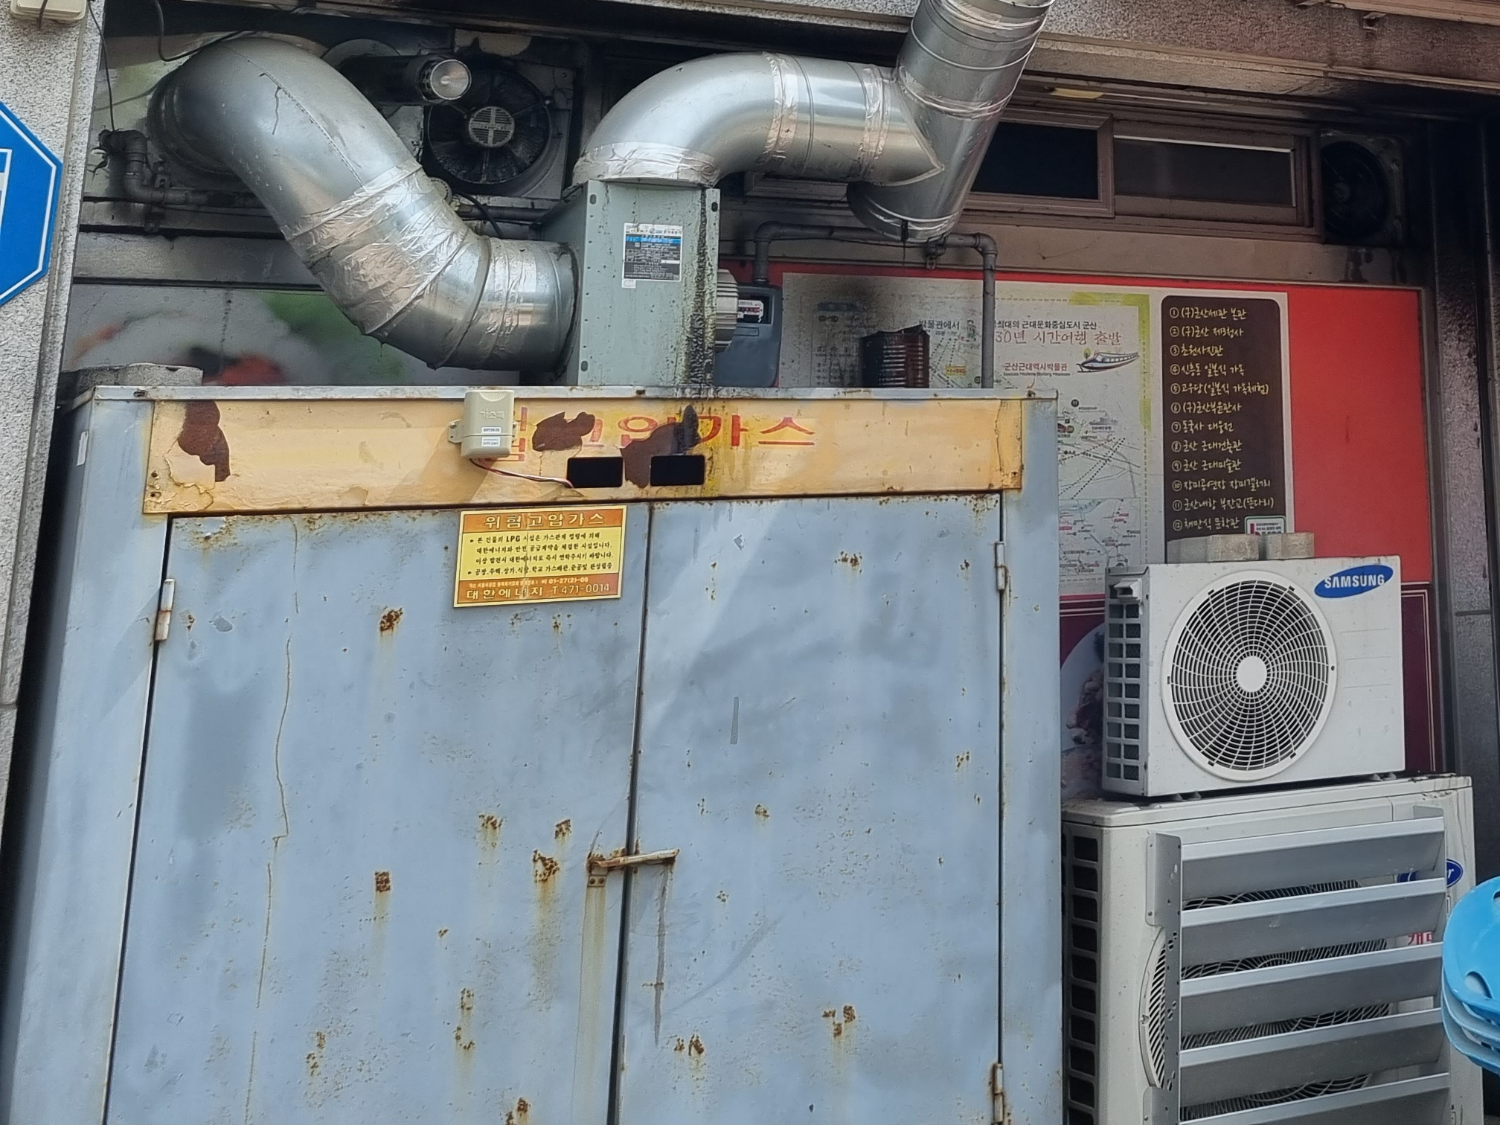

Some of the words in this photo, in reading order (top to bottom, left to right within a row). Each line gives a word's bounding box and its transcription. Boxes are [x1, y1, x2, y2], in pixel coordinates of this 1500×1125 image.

[1083, 321, 1097, 330] 군산
[995, 330, 1027, 344] 30년
[1033, 331, 1088, 345] 시간여행
[1094, 331, 1121, 345] 출발
[1182, 420, 1204, 434] 동국사
[1183, 440, 1198, 452] 군산
[1183, 459, 1198, 472] 군산
[484, 512, 605, 529] 위험고압가스
[506, 535, 521, 543] LPG
[1324, 572, 1386, 590] SAMSUNG
[561, 583, 610, 594] 471-0014
